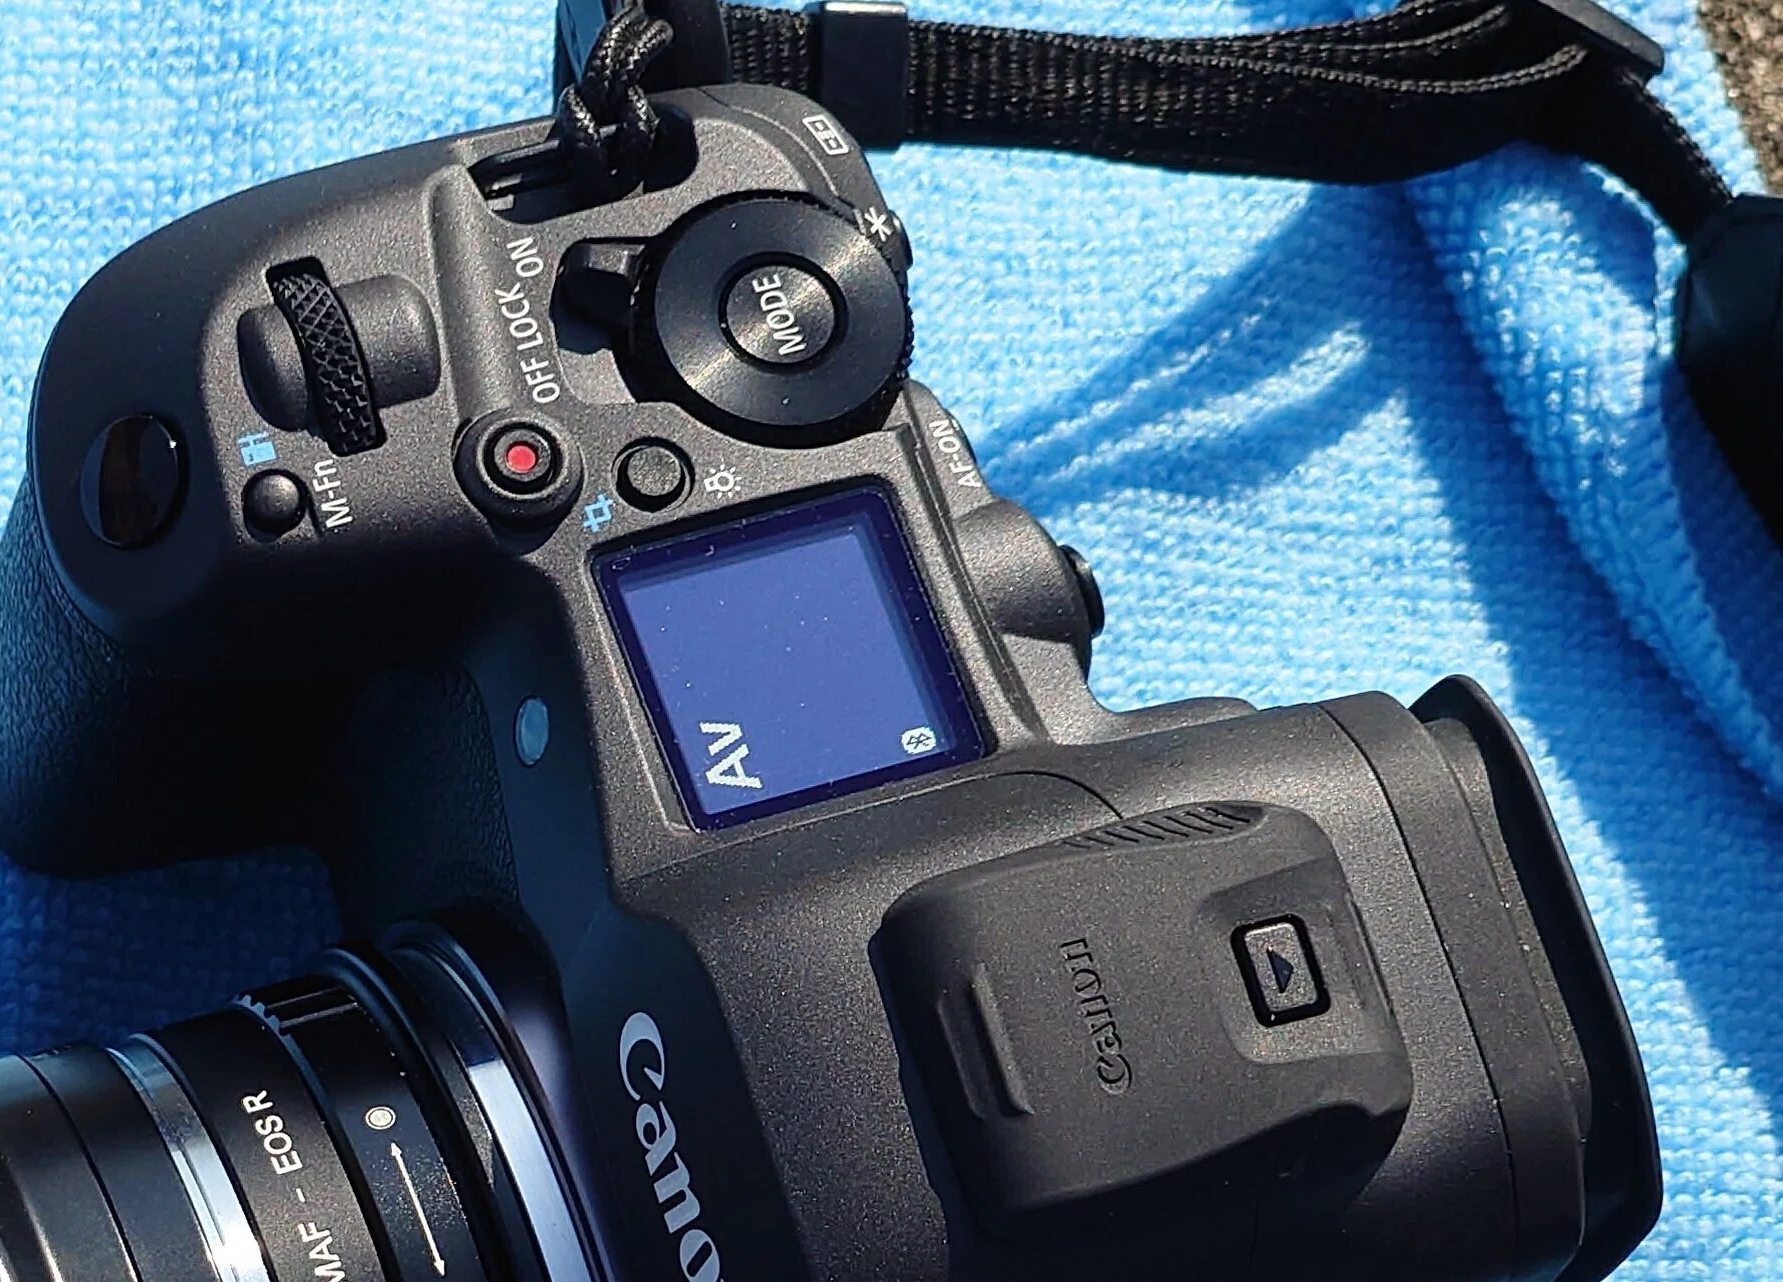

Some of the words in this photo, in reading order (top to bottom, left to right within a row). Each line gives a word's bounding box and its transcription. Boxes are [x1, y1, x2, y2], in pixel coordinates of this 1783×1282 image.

[506, 236, 545, 278] ON
[494, 282, 545, 351] LOCK
[752, 273, 808, 356] MODE
[519, 357, 561, 404] OFF
[928, 418, 983, 489] AF-ON
[312, 458, 355, 529] M-Fn
[698, 721, 763, 789] Av
[1059, 937, 1134, 1096] Canon
[254, 1114, 303, 1175] EOS
